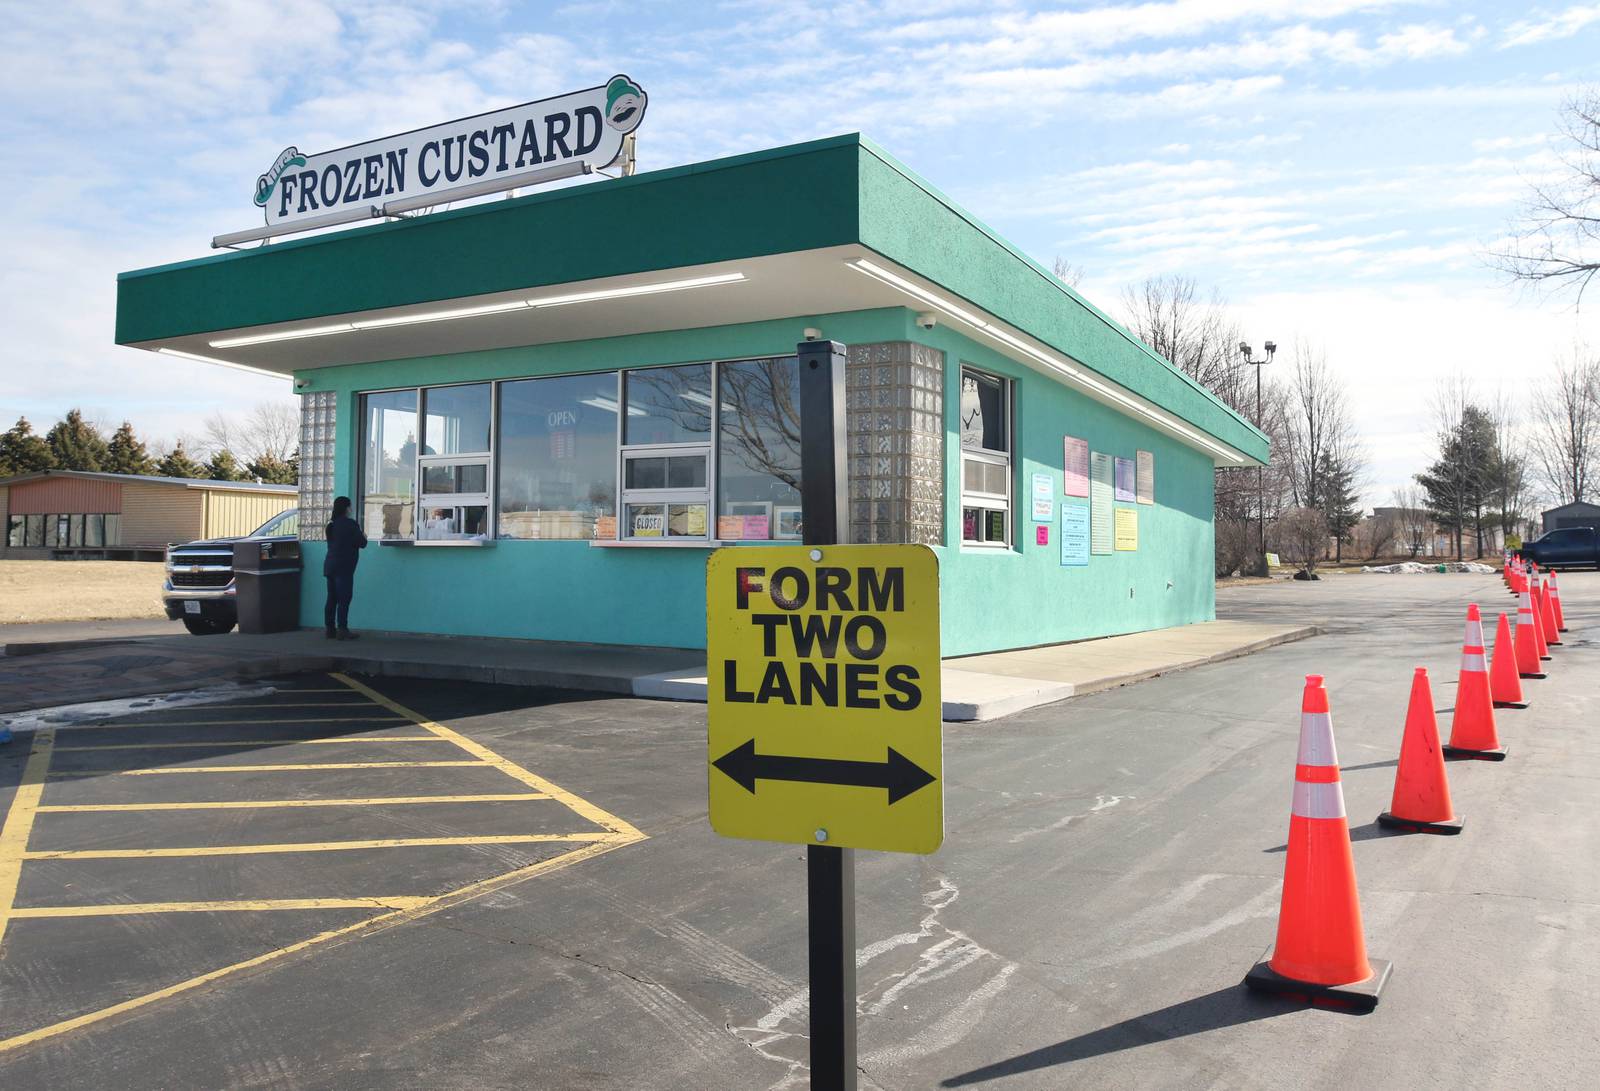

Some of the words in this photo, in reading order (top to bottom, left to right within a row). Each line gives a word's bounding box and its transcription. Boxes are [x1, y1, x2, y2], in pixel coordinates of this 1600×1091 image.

[278, 148, 408, 217] FROZEN
[418, 105, 603, 188] CUSTARD
[548, 410, 576, 426] OPEN
[636, 517, 662, 530] CLOSED
[736, 566, 905, 612] FORM
[752, 614, 887, 661] TWO
[724, 660, 922, 711] LANES
